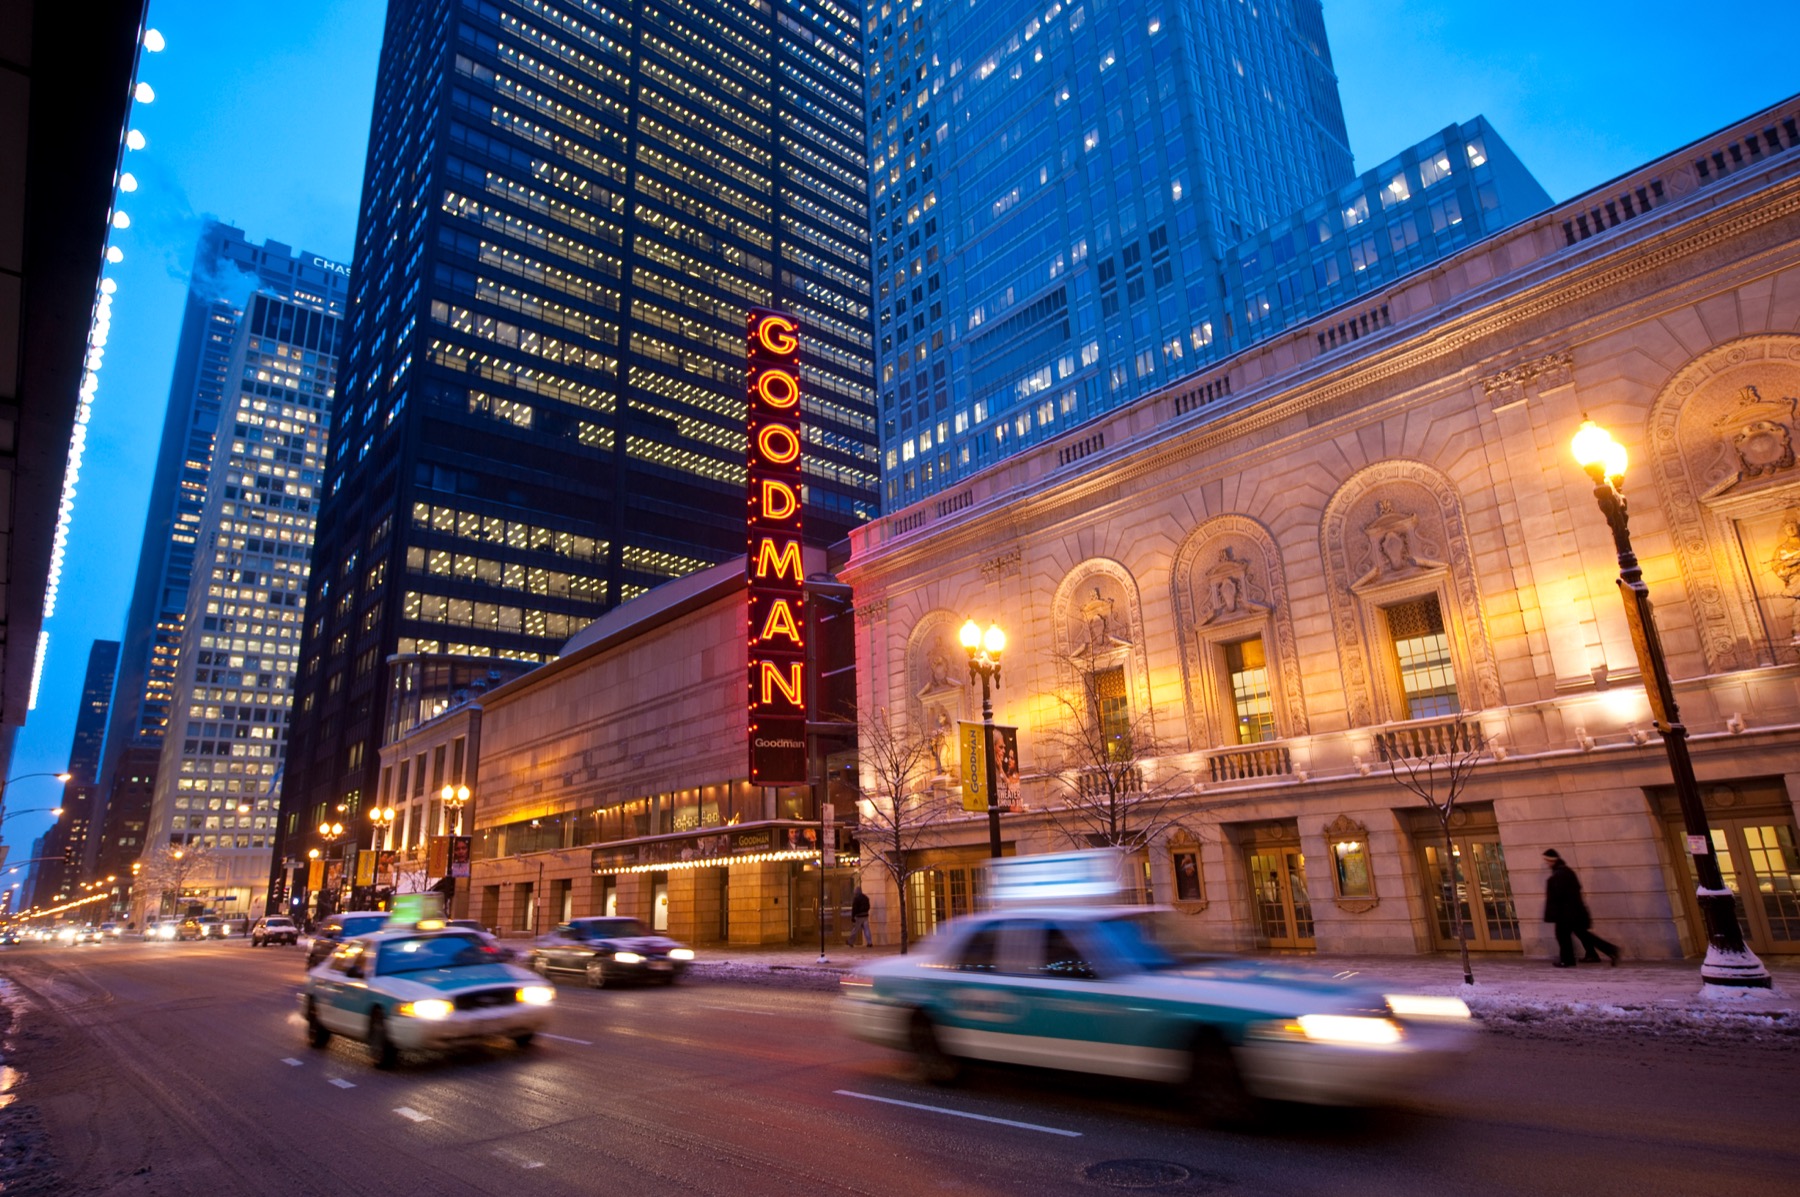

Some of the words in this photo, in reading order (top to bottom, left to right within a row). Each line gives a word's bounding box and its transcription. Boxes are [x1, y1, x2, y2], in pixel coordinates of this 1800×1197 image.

[313, 257, 351, 277] CHAS
[757, 315, 804, 705] GOODMAN
[755, 738, 805, 748] Goodman
[970, 730, 979, 793] GOODMAN
[739, 833, 769, 846] GOODMAN
